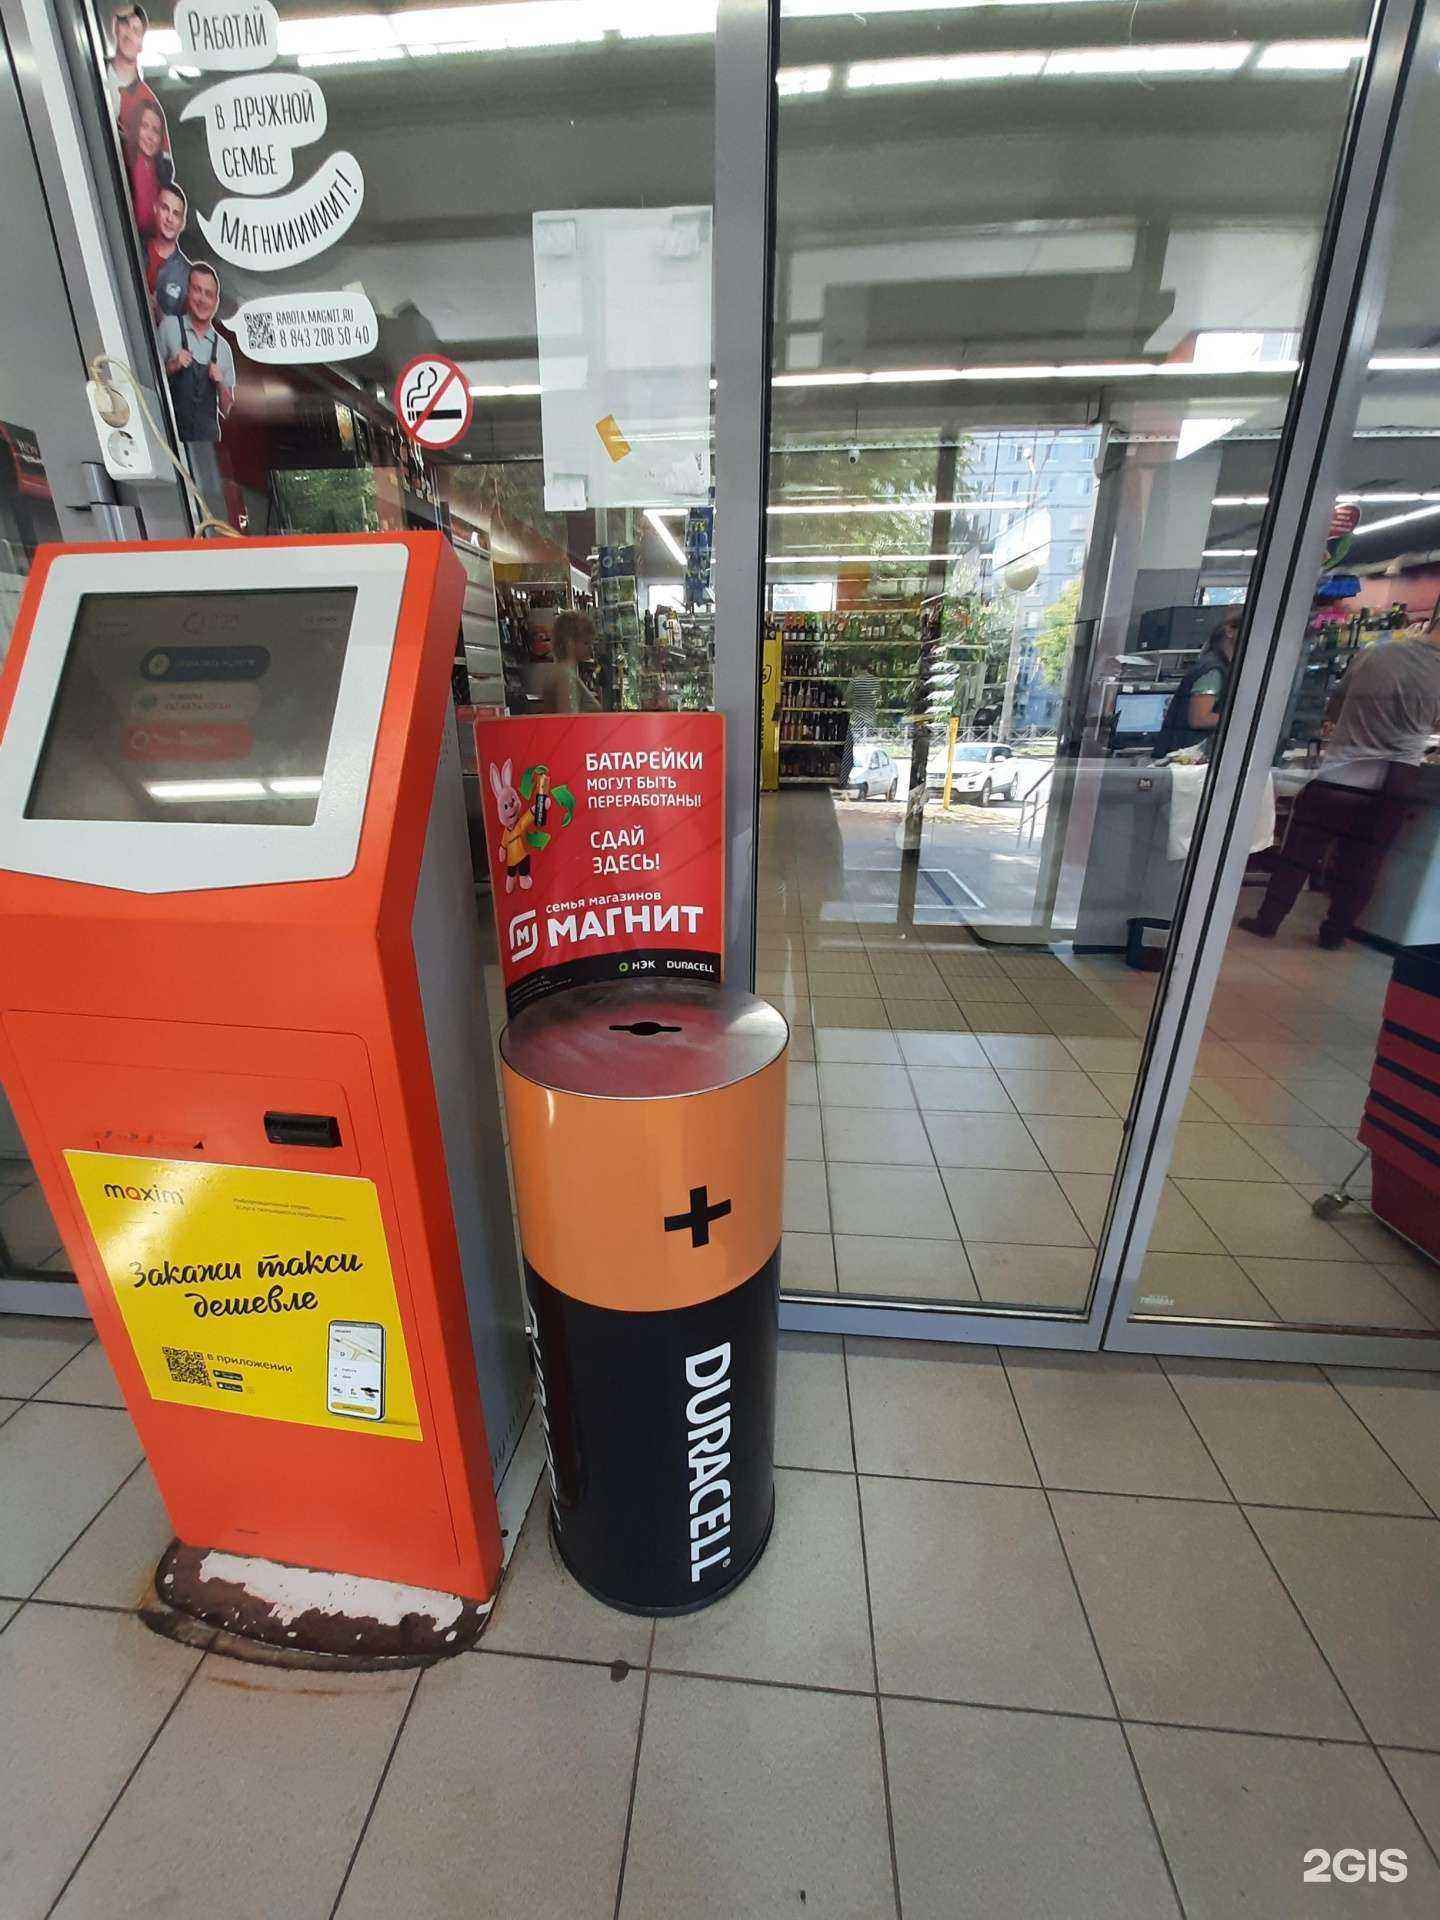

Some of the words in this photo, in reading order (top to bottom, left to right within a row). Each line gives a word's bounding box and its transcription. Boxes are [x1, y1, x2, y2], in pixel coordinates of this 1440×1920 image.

[233, 89, 316, 132] ДРУЖНОЙ
[222, 144, 278, 178] СЕМЬЕ
[276, 308, 354, 326] RABOTA.MAGNIT.RU
[279, 328, 287, 348] 8
[290, 327, 311, 347] 843
[314, 326, 335, 346] 208
[337, 326, 352, 346] 50
[355, 325, 370, 344] 40
[585, 747, 704, 772] БАТАРЕЙКИ
[586, 776, 633, 791] МОГУТ
[637, 775, 677, 789] БЫТЬ
[588, 793, 702, 809] ПЕРЕРАБОТАНЫ!
[590, 825, 645, 850] СДАЙ
[592, 854, 661, 876] ЗДЕСЬ!
[546, 899, 585, 915] семья
[589, 891, 662, 906] магазинов
[547, 905, 704, 948] МАГНИТ
[632, 960, 656, 970] НЭК
[666, 961, 715, 974] DURACELL
[103, 1183, 185, 1206] maxim
[129, 1260, 242, 1289] Закажи
[257, 1250, 364, 1279] такси
[184, 1284, 319, 1318] дешевле
[216, 1354, 294, 1373] приложении
